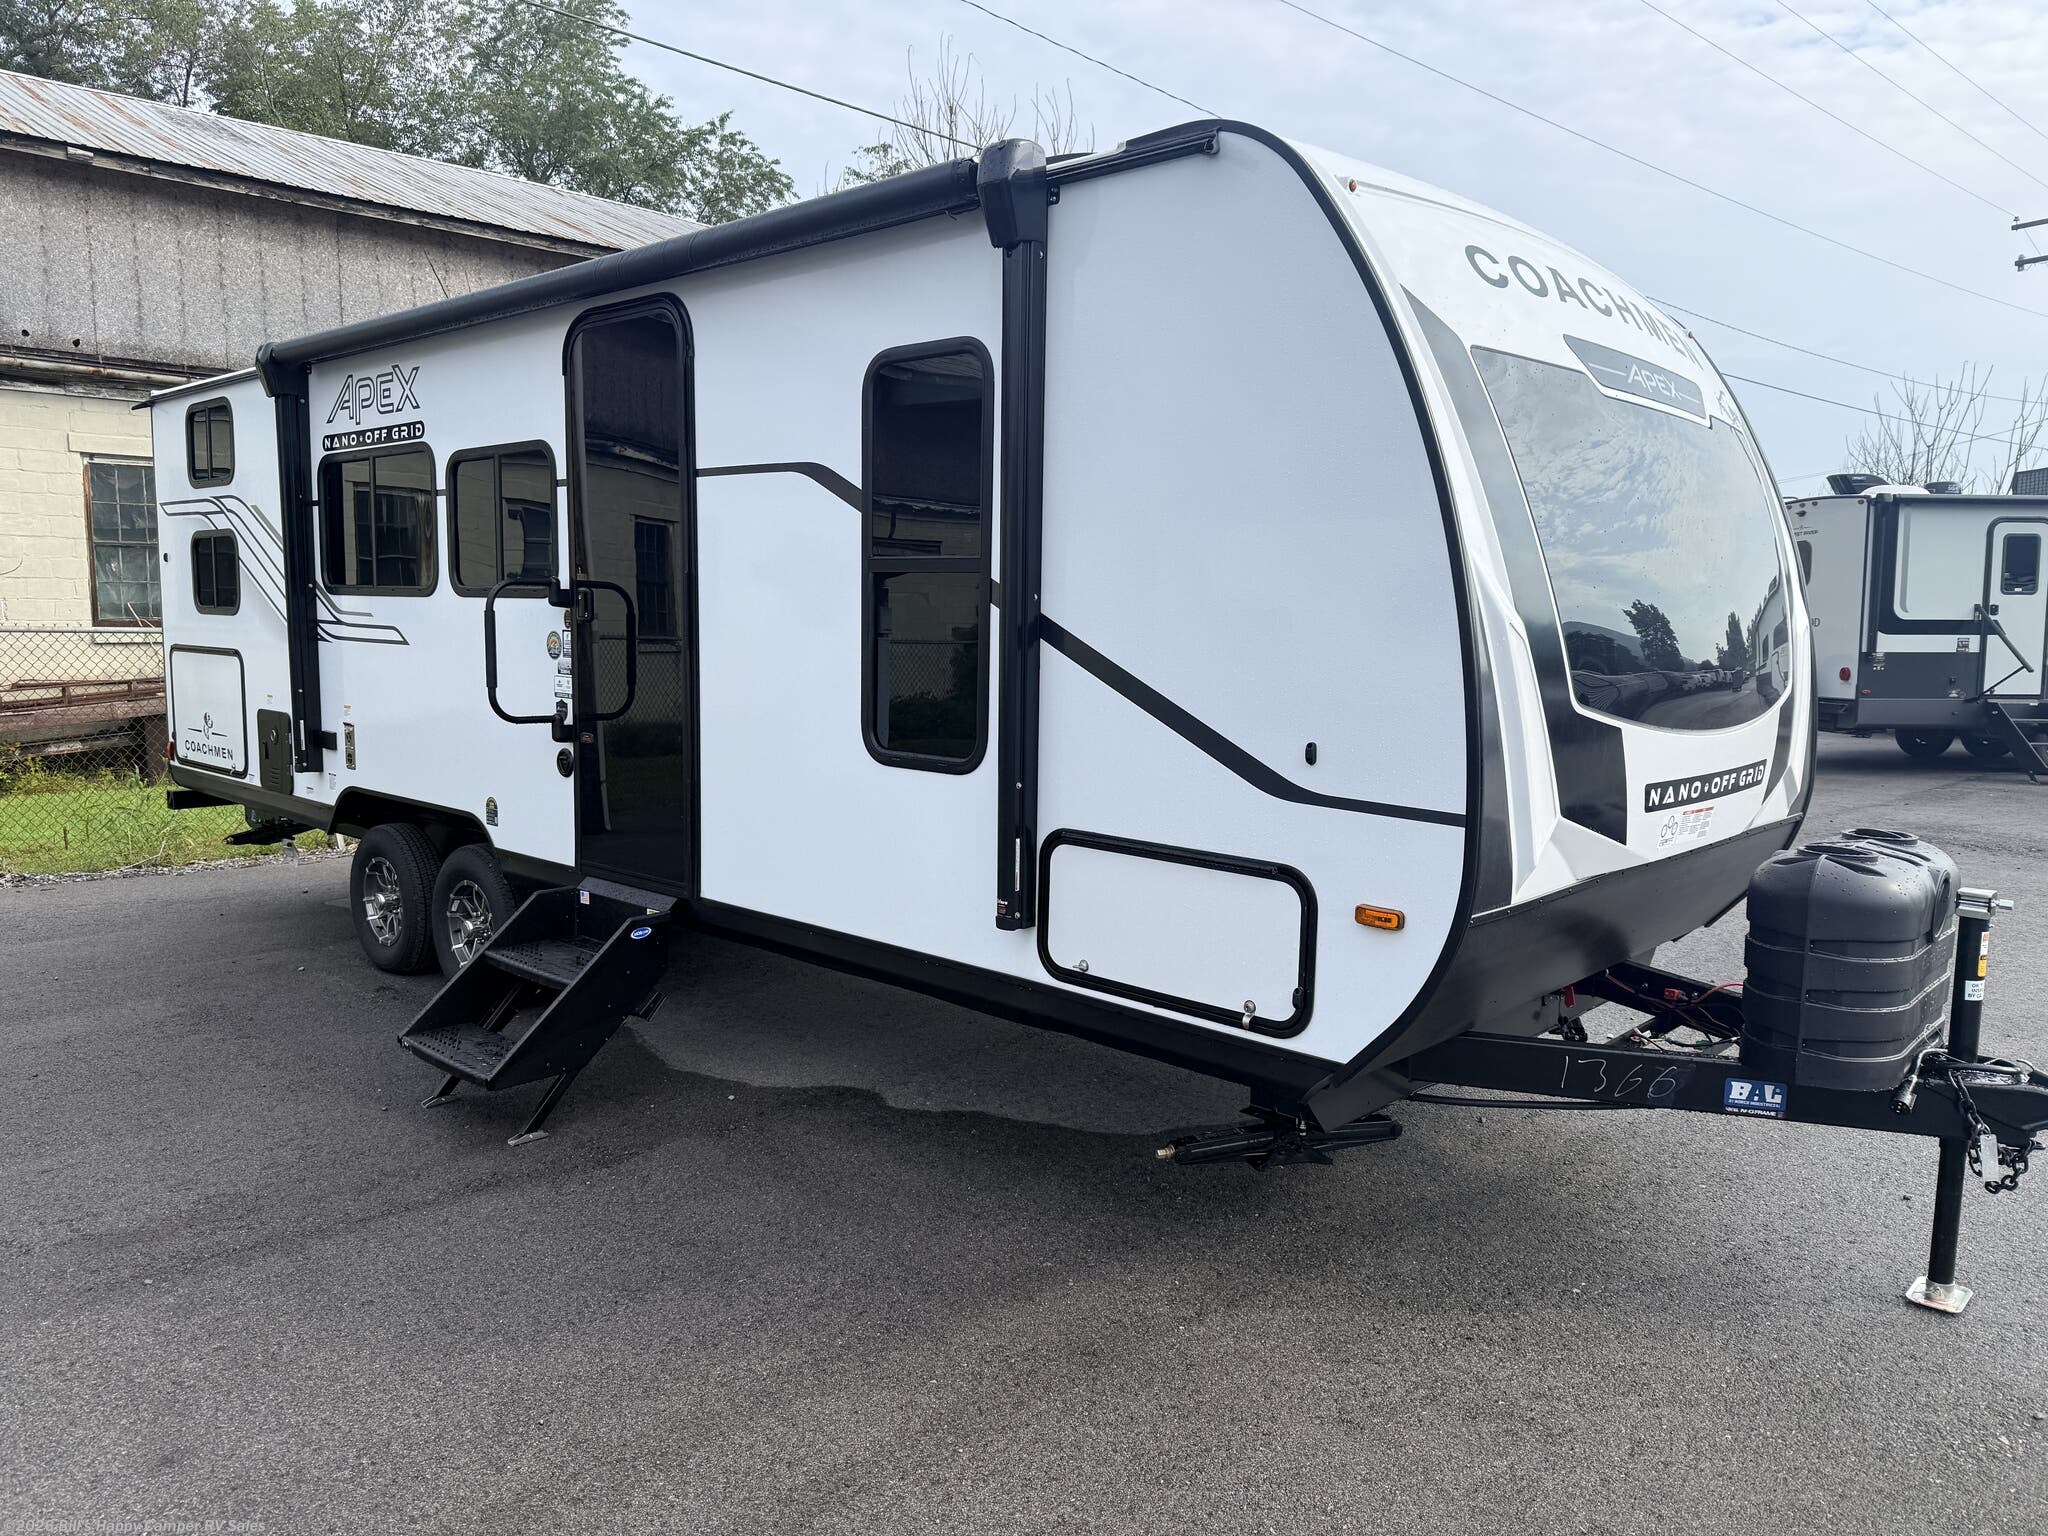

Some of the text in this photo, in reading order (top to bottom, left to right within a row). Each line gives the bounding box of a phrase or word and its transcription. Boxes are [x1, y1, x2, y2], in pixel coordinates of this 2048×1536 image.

[326, 364, 420, 425] APEX
[1627, 363, 1681, 400] APEX
[391, 424, 423, 439] GRID
[185, 740, 233, 760] COACHMEN
[1740, 765, 1764, 786] GRID
[1561, 1056, 1677, 1098] 1366
